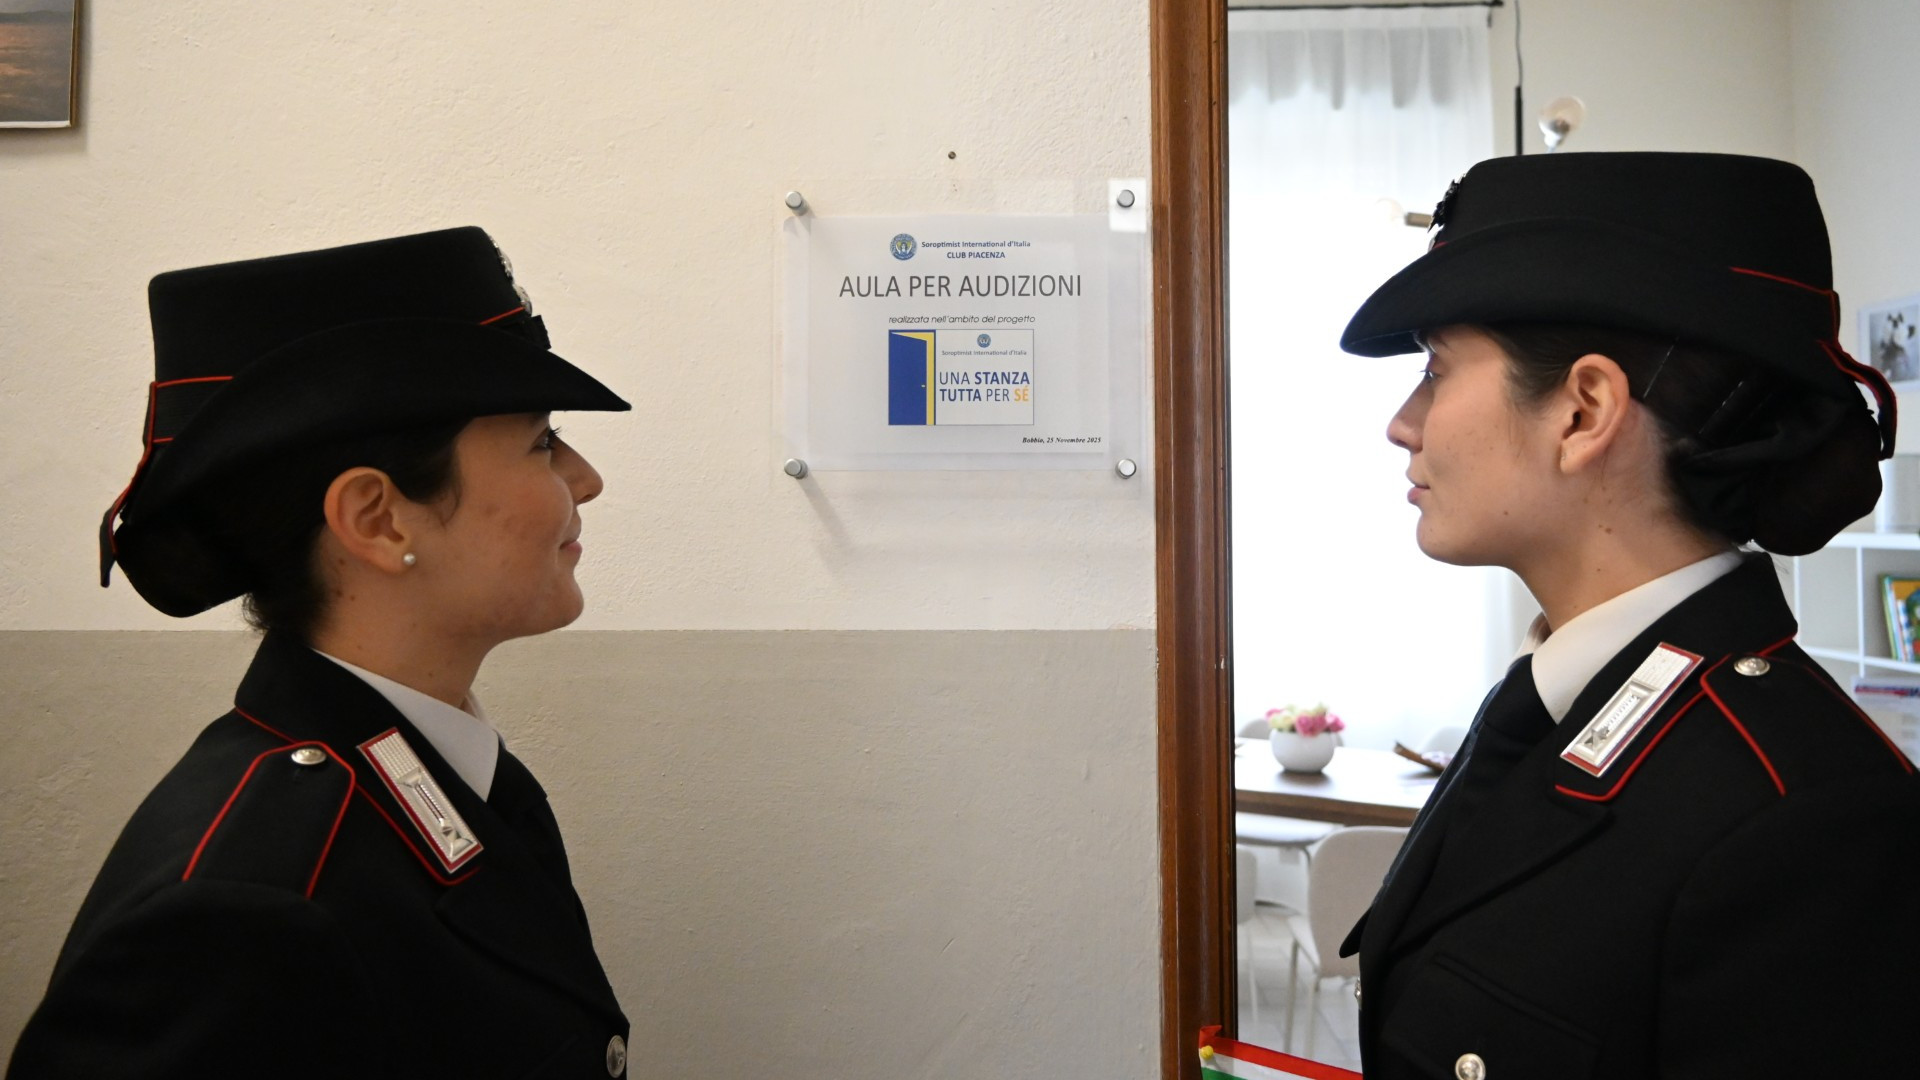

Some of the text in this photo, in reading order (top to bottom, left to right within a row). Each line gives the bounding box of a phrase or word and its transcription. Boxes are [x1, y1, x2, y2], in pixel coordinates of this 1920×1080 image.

[921, 241, 960, 249] Soroptimist
[1007, 240, 1031, 248] d'Italia
[947, 251, 1006, 259] CLUB PIACENZA
[839, 274, 1082, 298] AULA PER AUDIZIONI
[888, 315, 929, 324] realizzata
[981, 315, 996, 323] del
[997, 315, 1036, 325] progetto
[939, 371, 1030, 385] UNA STANZA
[939, 385, 1030, 402] TUTTA PER SÉ
